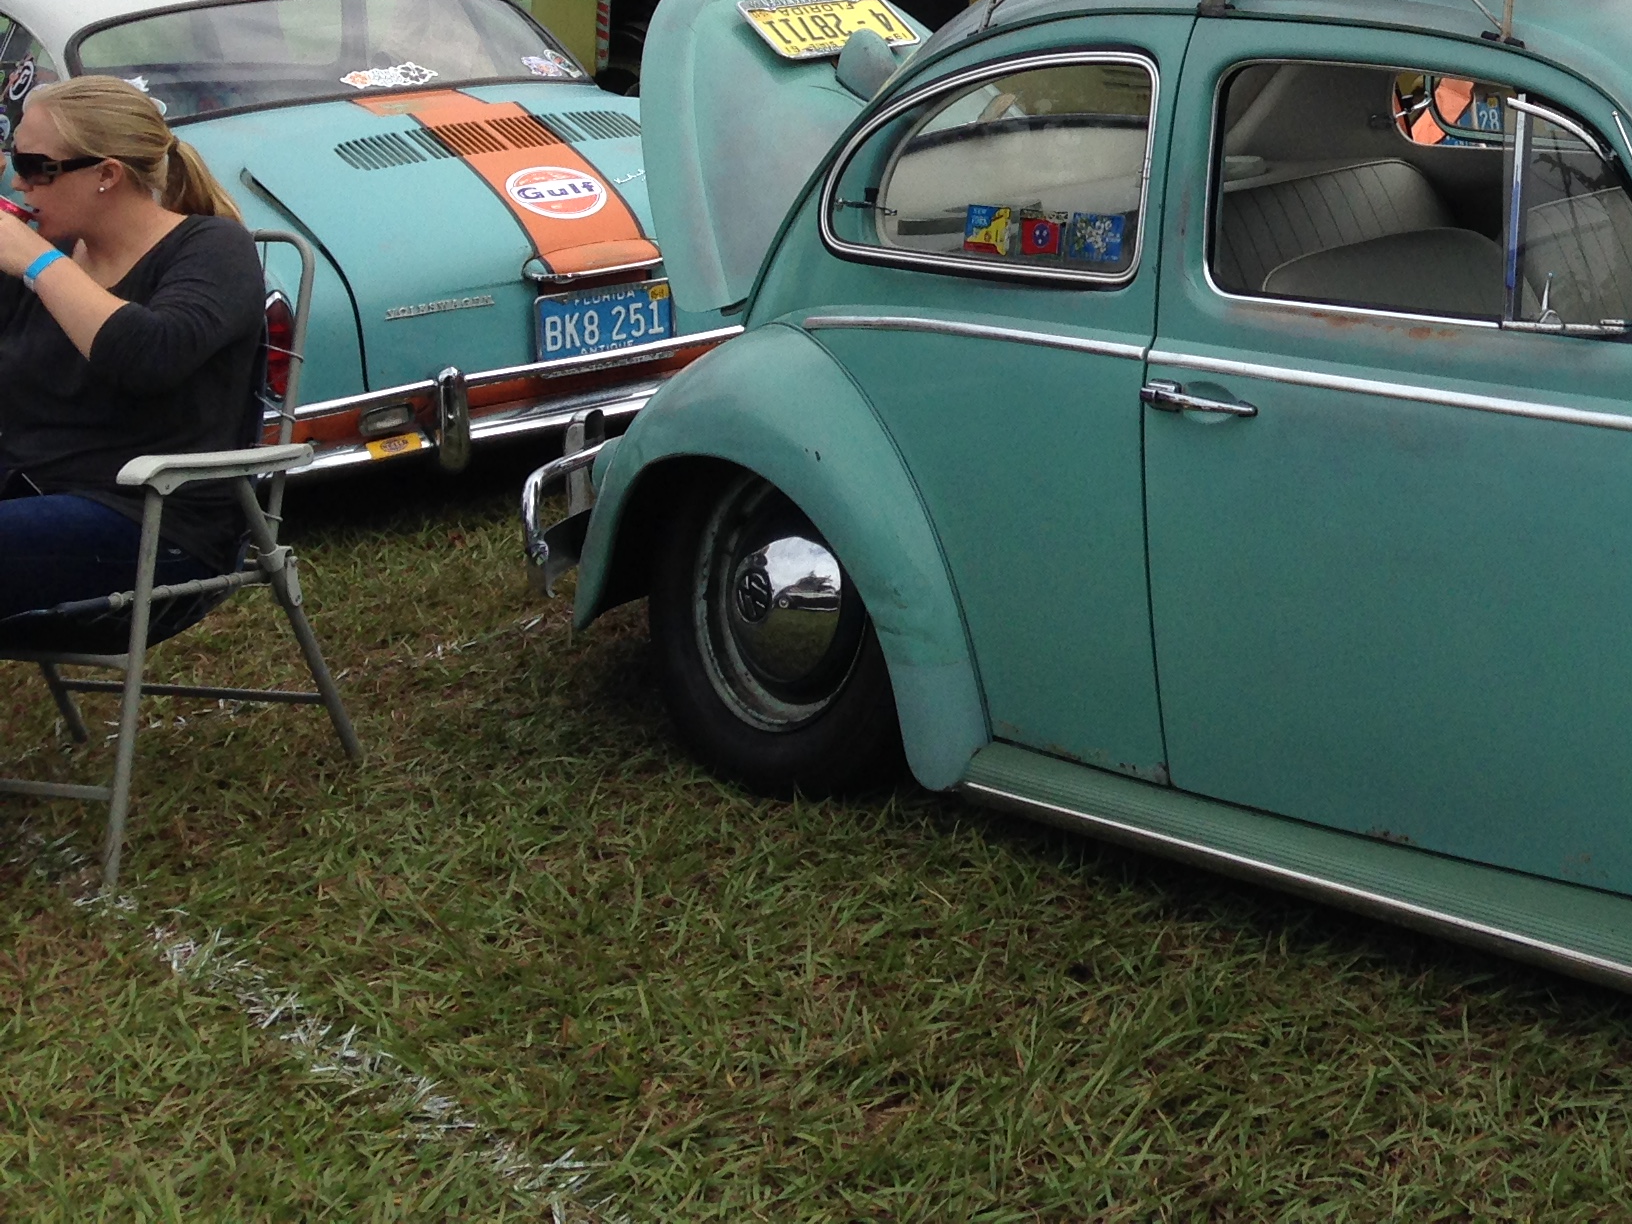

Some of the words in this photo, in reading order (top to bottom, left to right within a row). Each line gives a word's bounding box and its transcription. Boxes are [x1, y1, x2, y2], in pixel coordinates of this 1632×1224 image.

[779, 2, 855, 16] FLORIDA
[869, 8, 894, 32] 4
[764, 13, 853, 44] 28711
[516, 180, 596, 201] Gulf
[545, 309, 600, 353] BK8
[611, 300, 666, 342] 251
